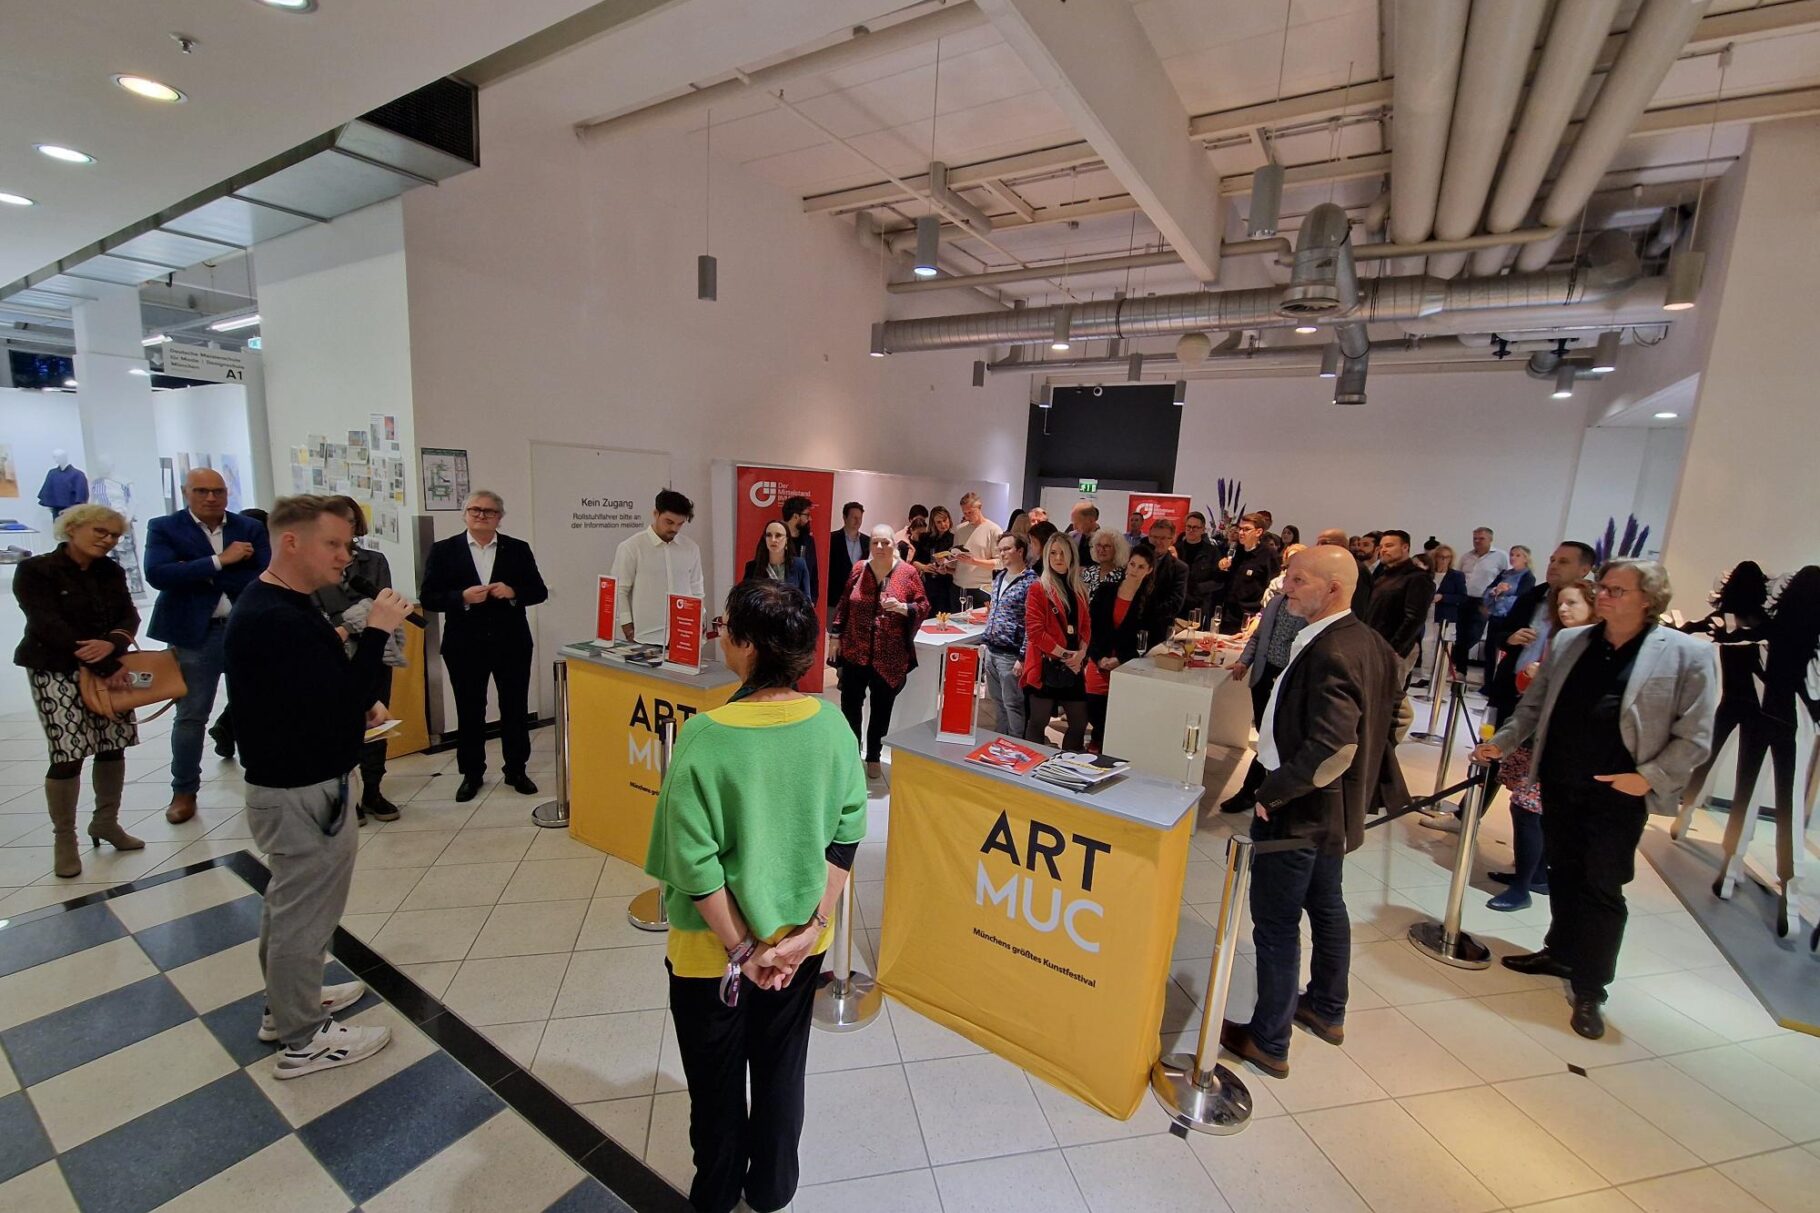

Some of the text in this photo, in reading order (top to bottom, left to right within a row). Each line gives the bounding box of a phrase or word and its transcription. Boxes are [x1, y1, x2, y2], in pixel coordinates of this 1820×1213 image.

[226, 369, 243, 380] A1
[572, 512, 618, 521] Rollstuhlfahrer
[581, 498, 634, 510] Kein Zugang
[584, 521, 619, 529] Information
[629, 693, 697, 735] ART
[980, 809, 1111, 892] ART
[976, 858, 1104, 953] MUC
[973, 927, 1096, 988] Münchens größtes Kunstfestival
